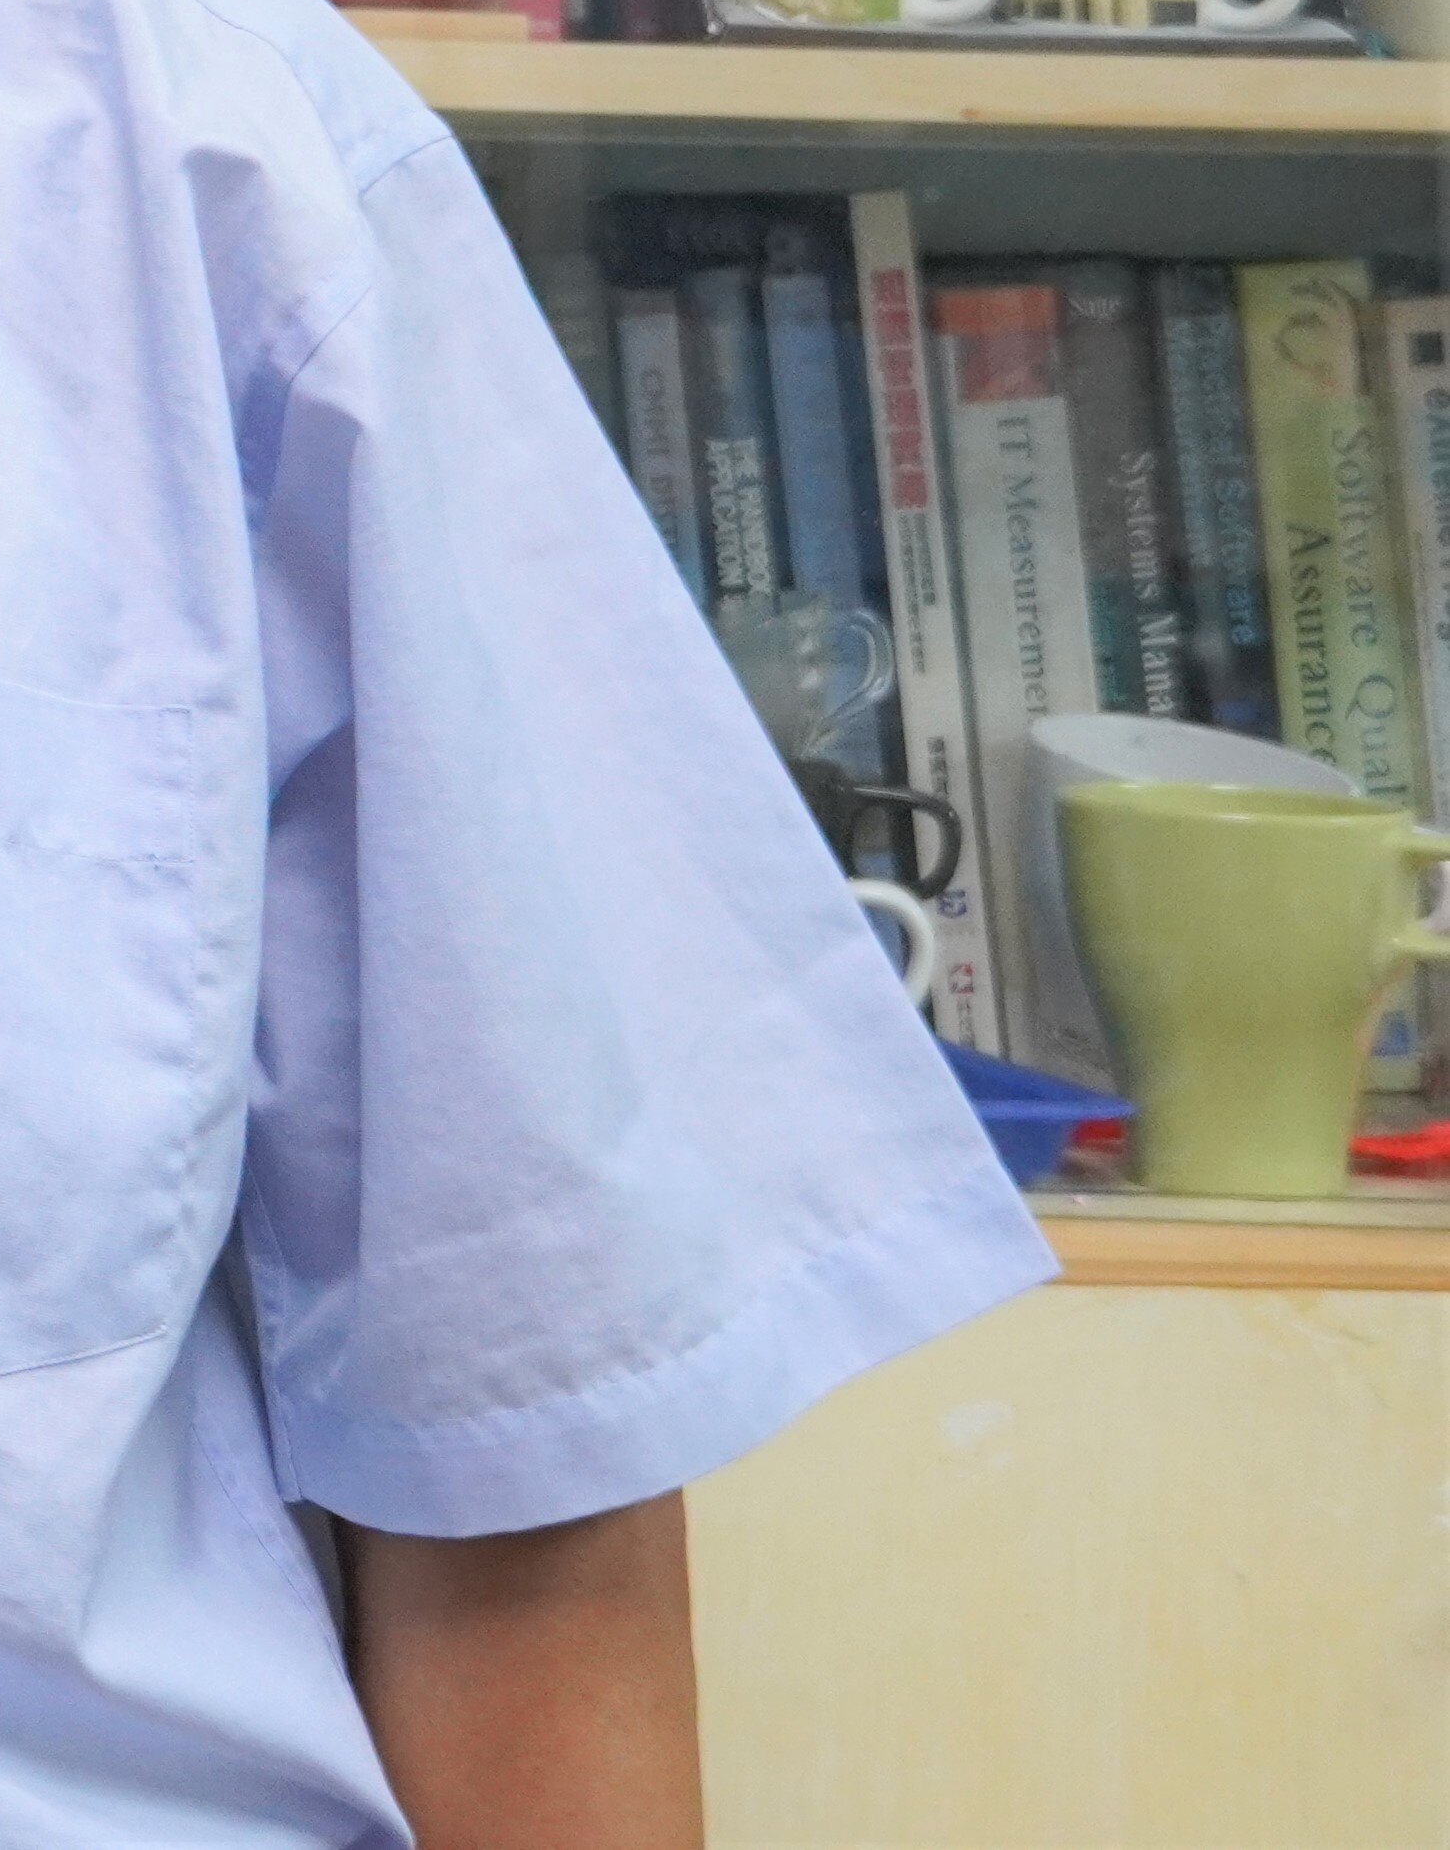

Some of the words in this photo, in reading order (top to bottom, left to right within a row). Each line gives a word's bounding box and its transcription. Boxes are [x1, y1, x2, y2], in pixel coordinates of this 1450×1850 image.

[732, 435, 760, 480] THE
[996, 415, 1032, 455] IT
[704, 437, 743, 587] APPLICATION
[1108, 450, 1162, 601] Systems
[1137, 613, 1178, 720] Mana
[1213, 476, 1257, 646] Software
[1332, 427, 1381, 648] Software
[1345, 673, 1410, 798] Qual
